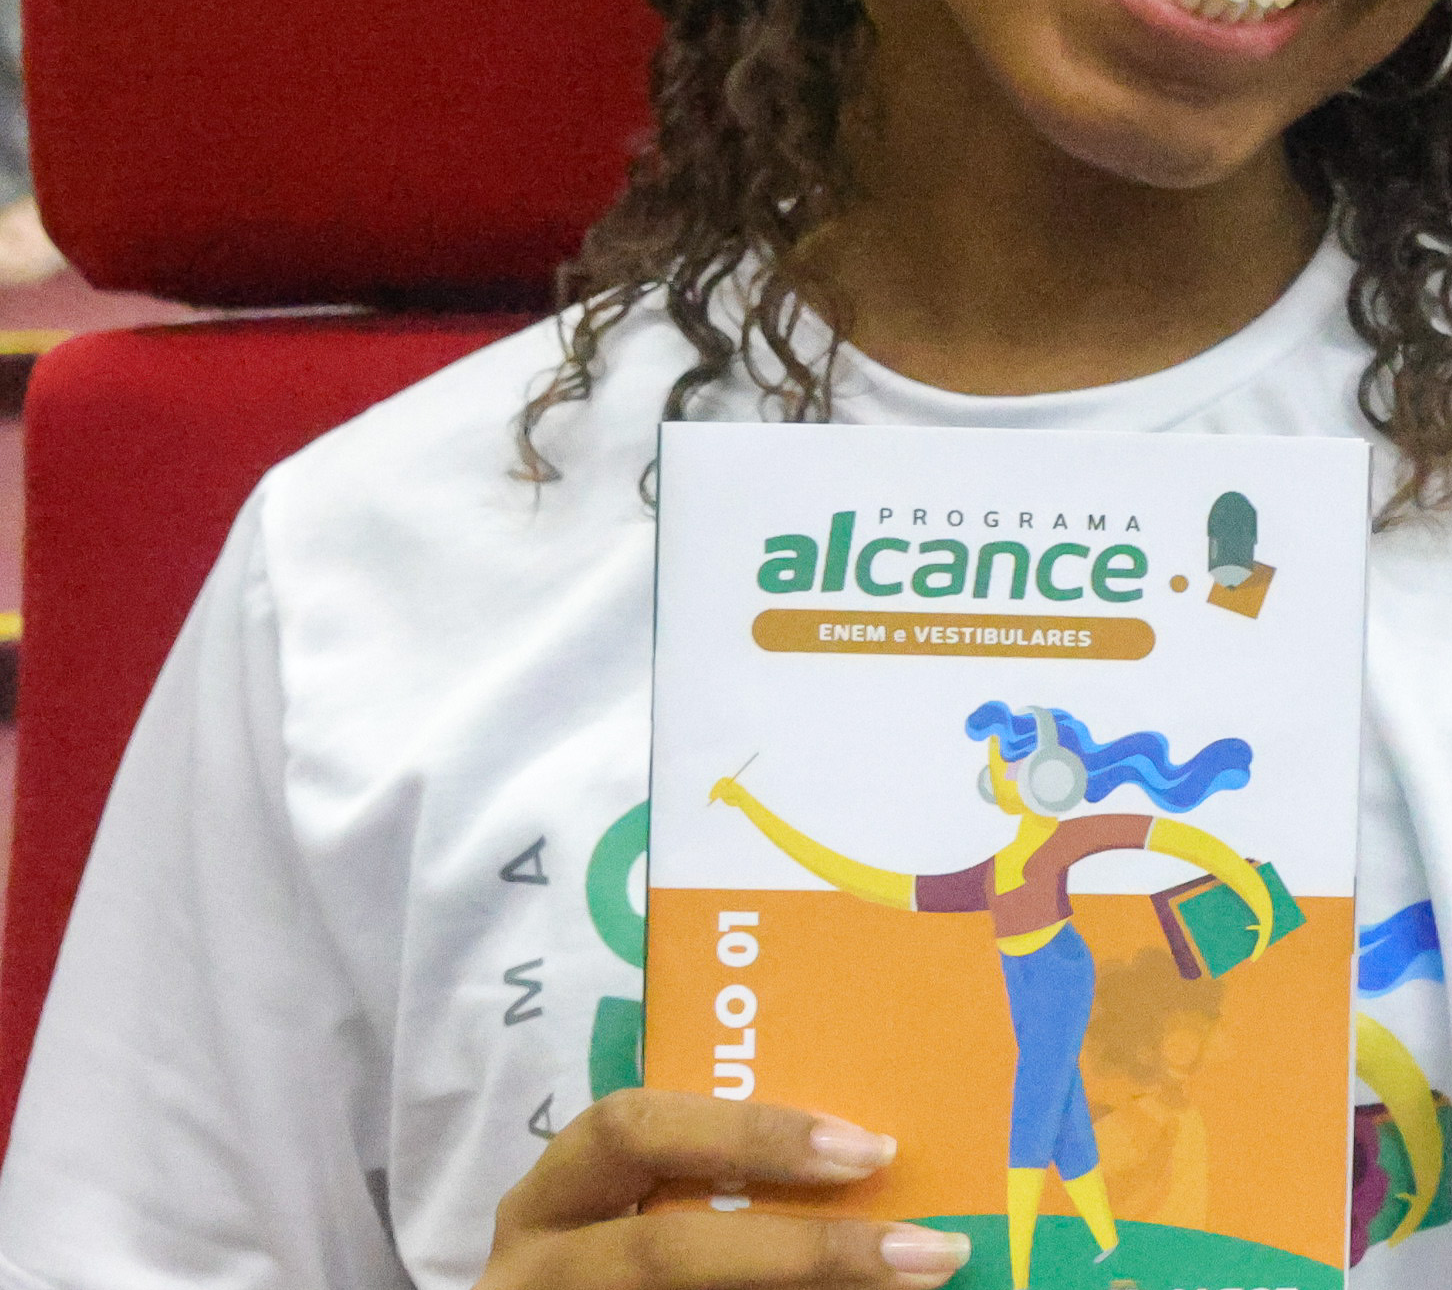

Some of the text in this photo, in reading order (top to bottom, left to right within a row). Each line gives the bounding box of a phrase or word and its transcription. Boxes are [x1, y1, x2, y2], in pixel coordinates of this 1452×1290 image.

[878, 508, 1141, 532] PROGRAMA
[757, 511, 1149, 603] alcance
[818, 623, 1092, 647] ENEM e VESTIBULARES
[716, 911, 760, 968] 01
